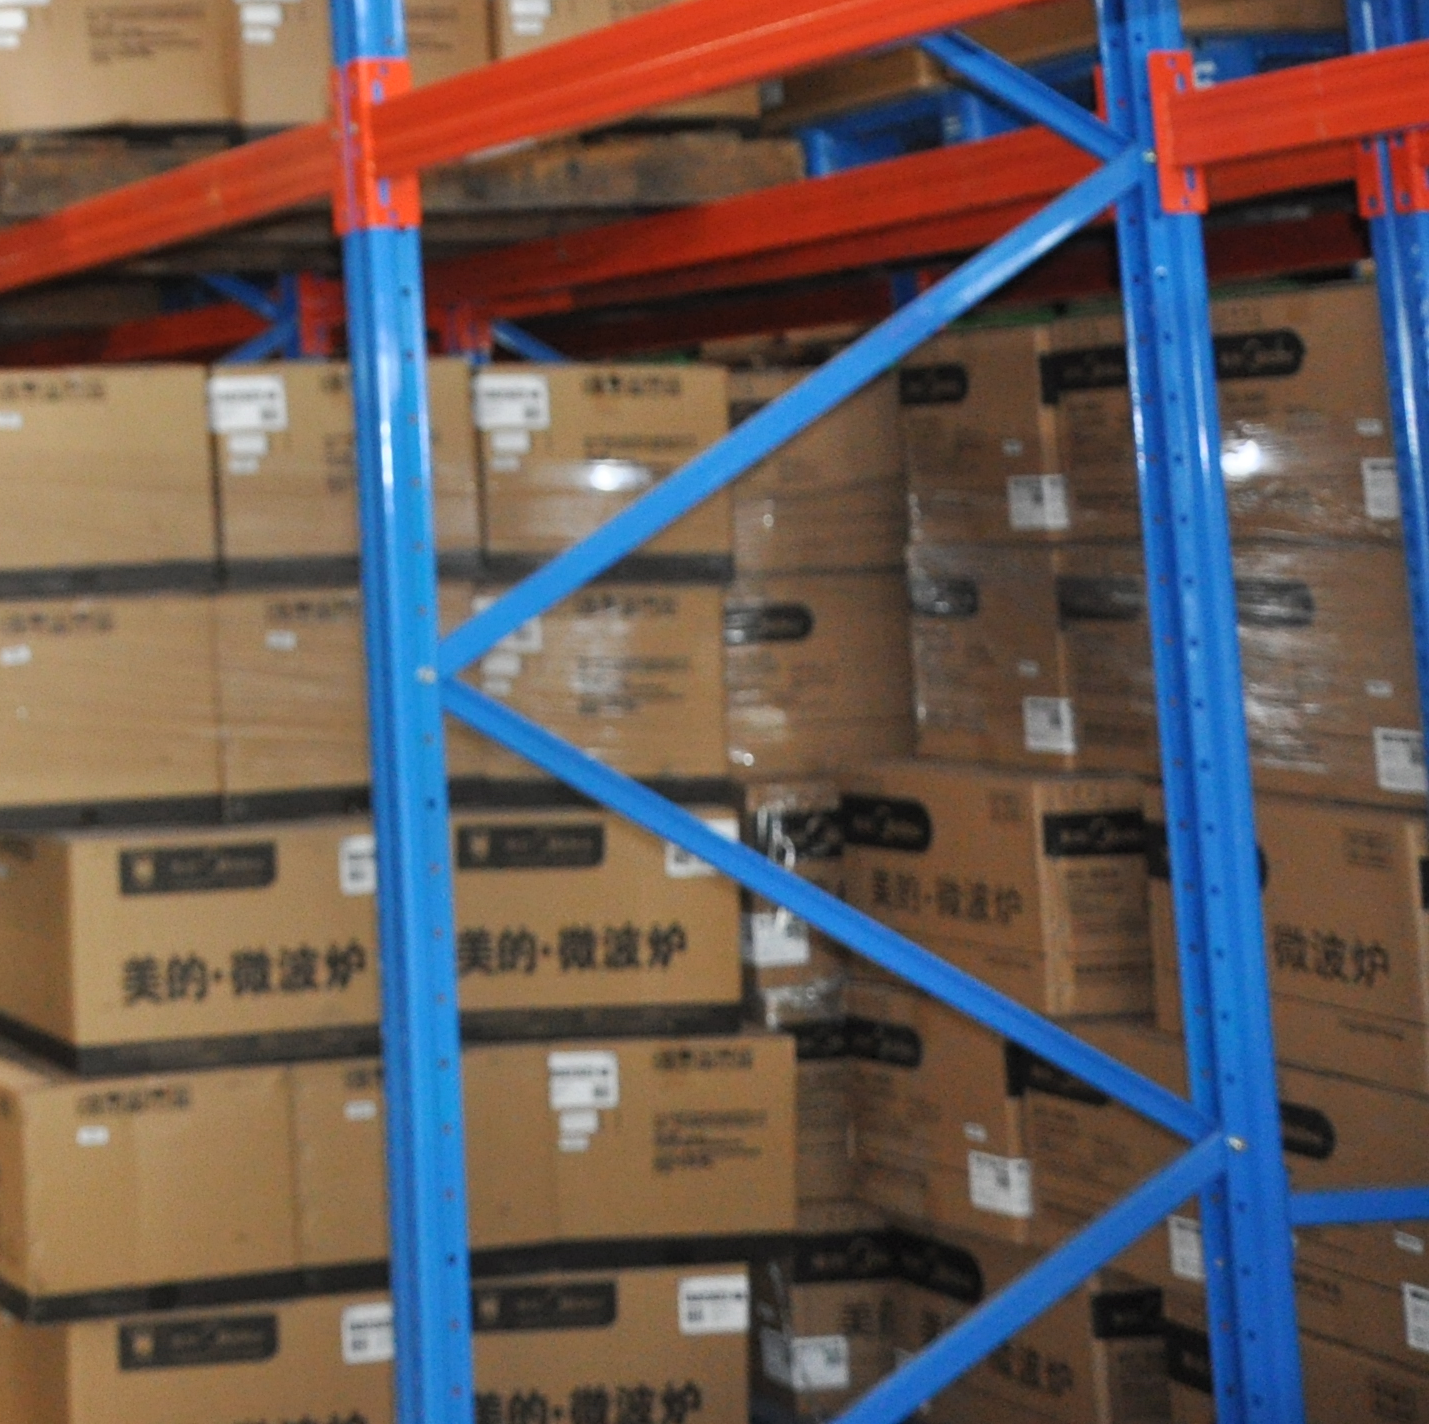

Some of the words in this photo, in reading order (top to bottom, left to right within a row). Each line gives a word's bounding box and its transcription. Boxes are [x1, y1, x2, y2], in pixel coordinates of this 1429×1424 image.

[123, 939, 367, 1005] 美的·微波炉
[458, 921, 688, 975] 美的·微波炉
